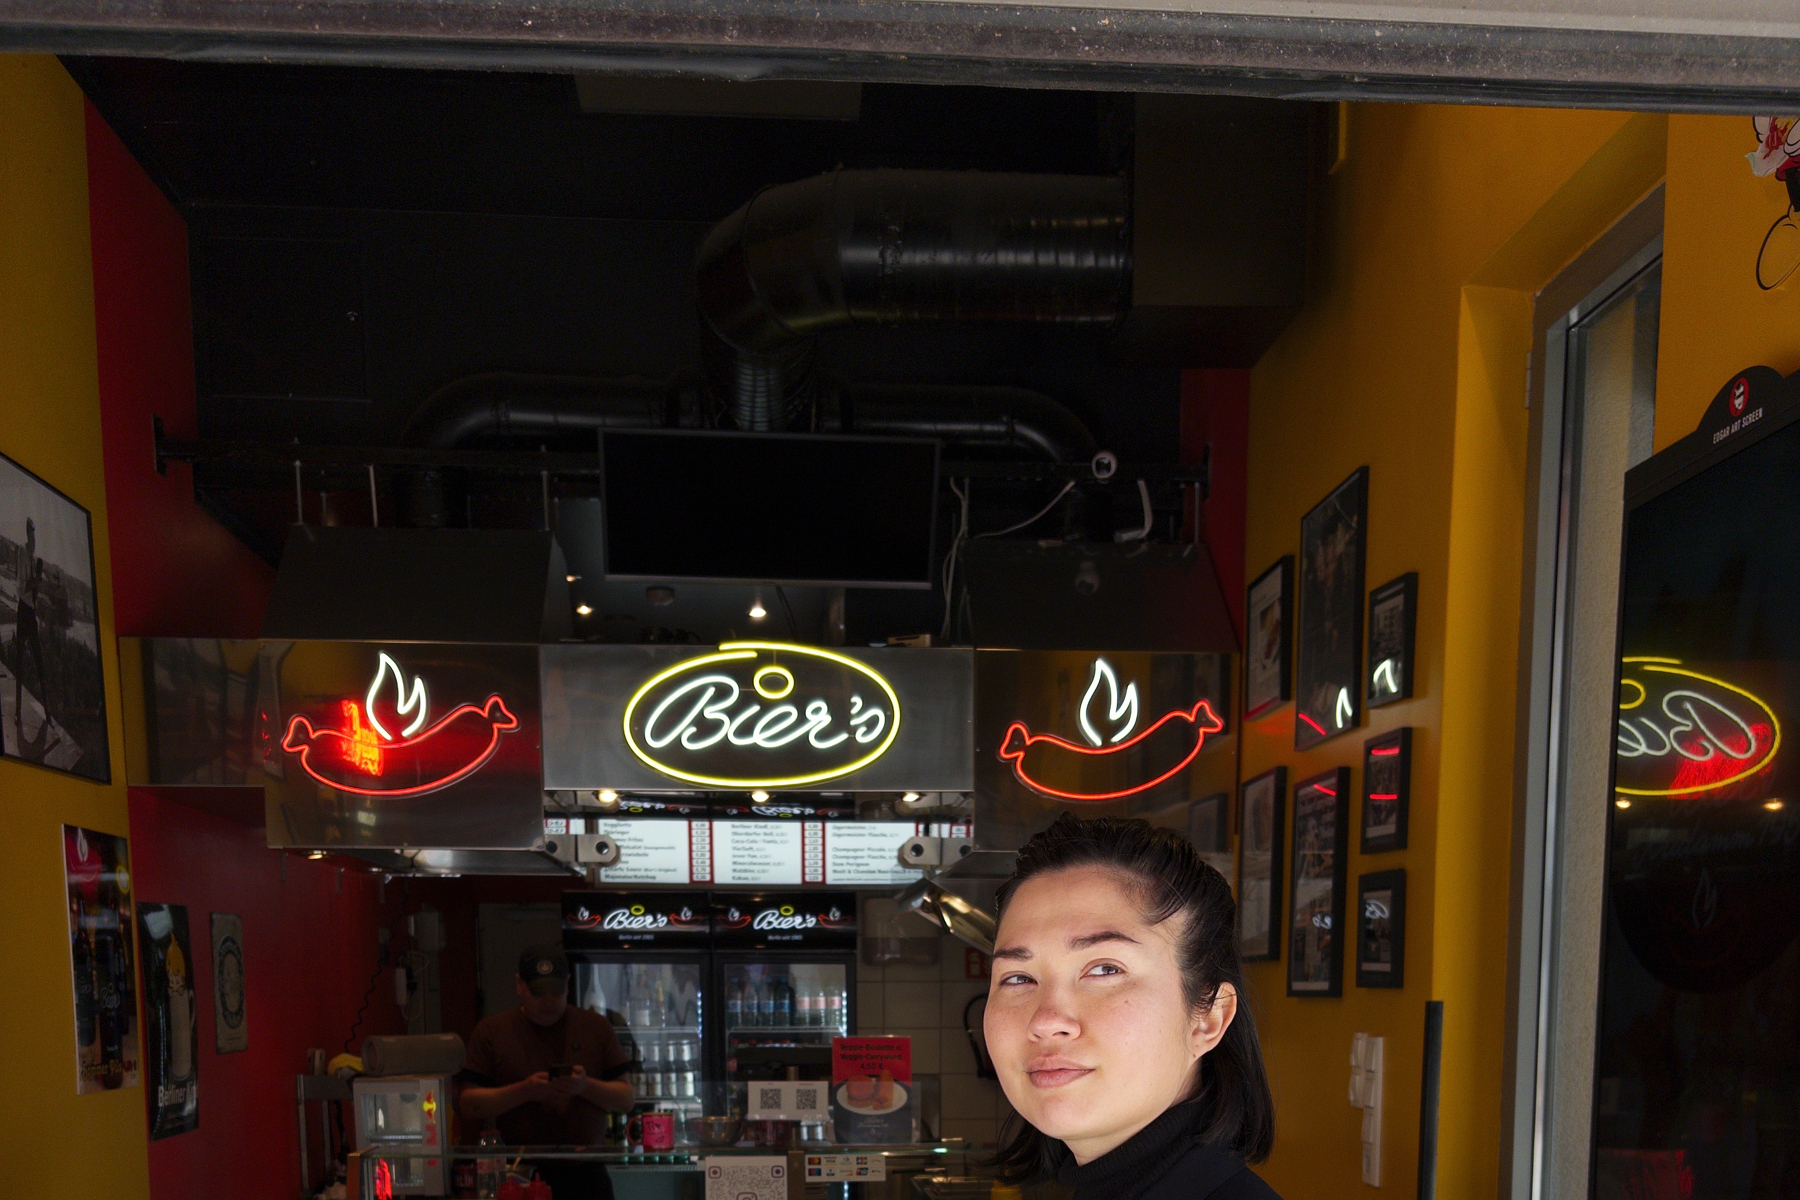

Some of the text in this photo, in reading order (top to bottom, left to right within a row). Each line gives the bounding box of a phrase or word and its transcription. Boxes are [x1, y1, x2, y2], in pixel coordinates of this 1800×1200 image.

[1712, 407, 1763, 445] EDGAR ART SCREEN
[645, 667, 887, 750] Bier's
[603, 905, 668, 930] Bier's
[753, 905, 817, 930] Bier's
[840, 1053, 903, 1061] Veggie-Currywurst
[158, 1083, 186, 1107] Berliner
